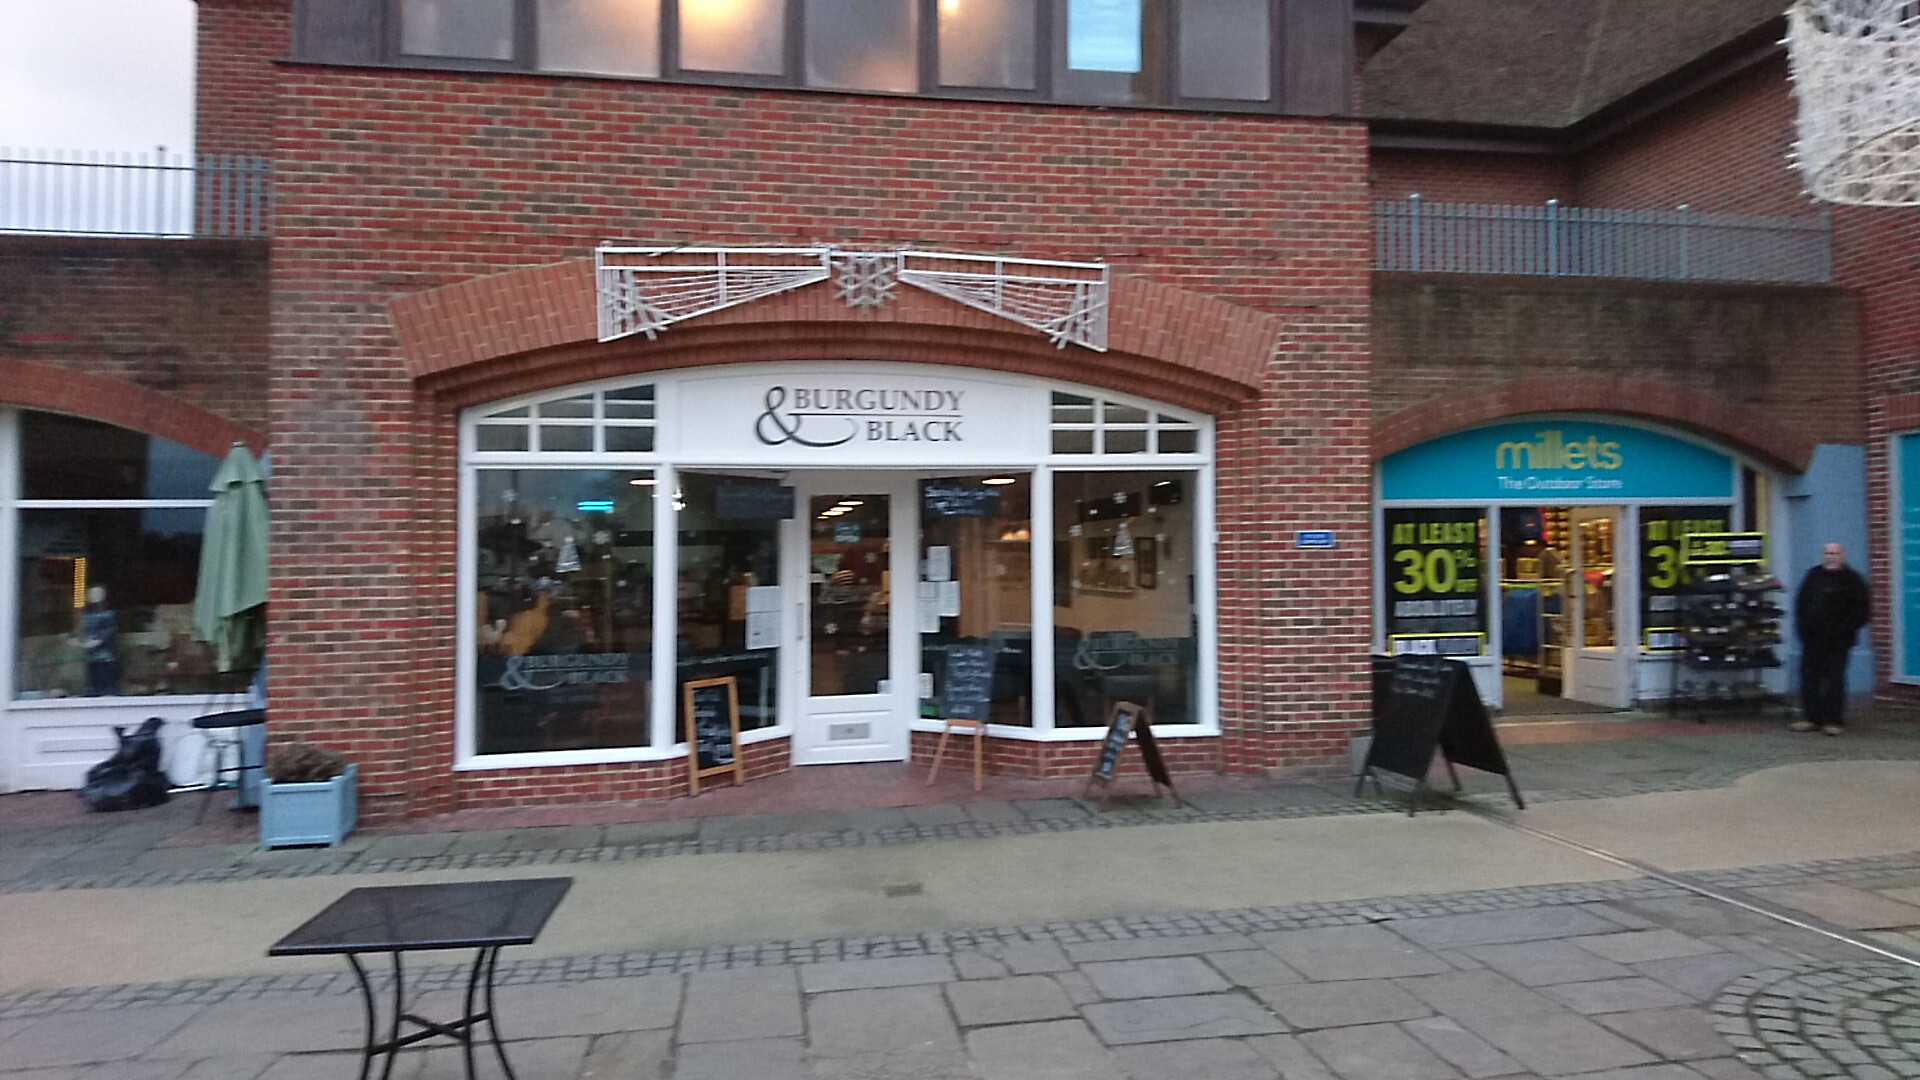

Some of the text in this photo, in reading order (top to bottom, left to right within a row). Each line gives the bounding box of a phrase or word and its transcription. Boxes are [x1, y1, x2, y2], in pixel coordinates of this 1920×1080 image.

[794, 388, 964, 411] BURGUNDY
[866, 421, 963, 442] BLACK
[1496, 429, 1623, 470] millets
[1496, 475, 1624, 490] The Outdoor Store
[1418, 521, 1477, 545] LEAST
